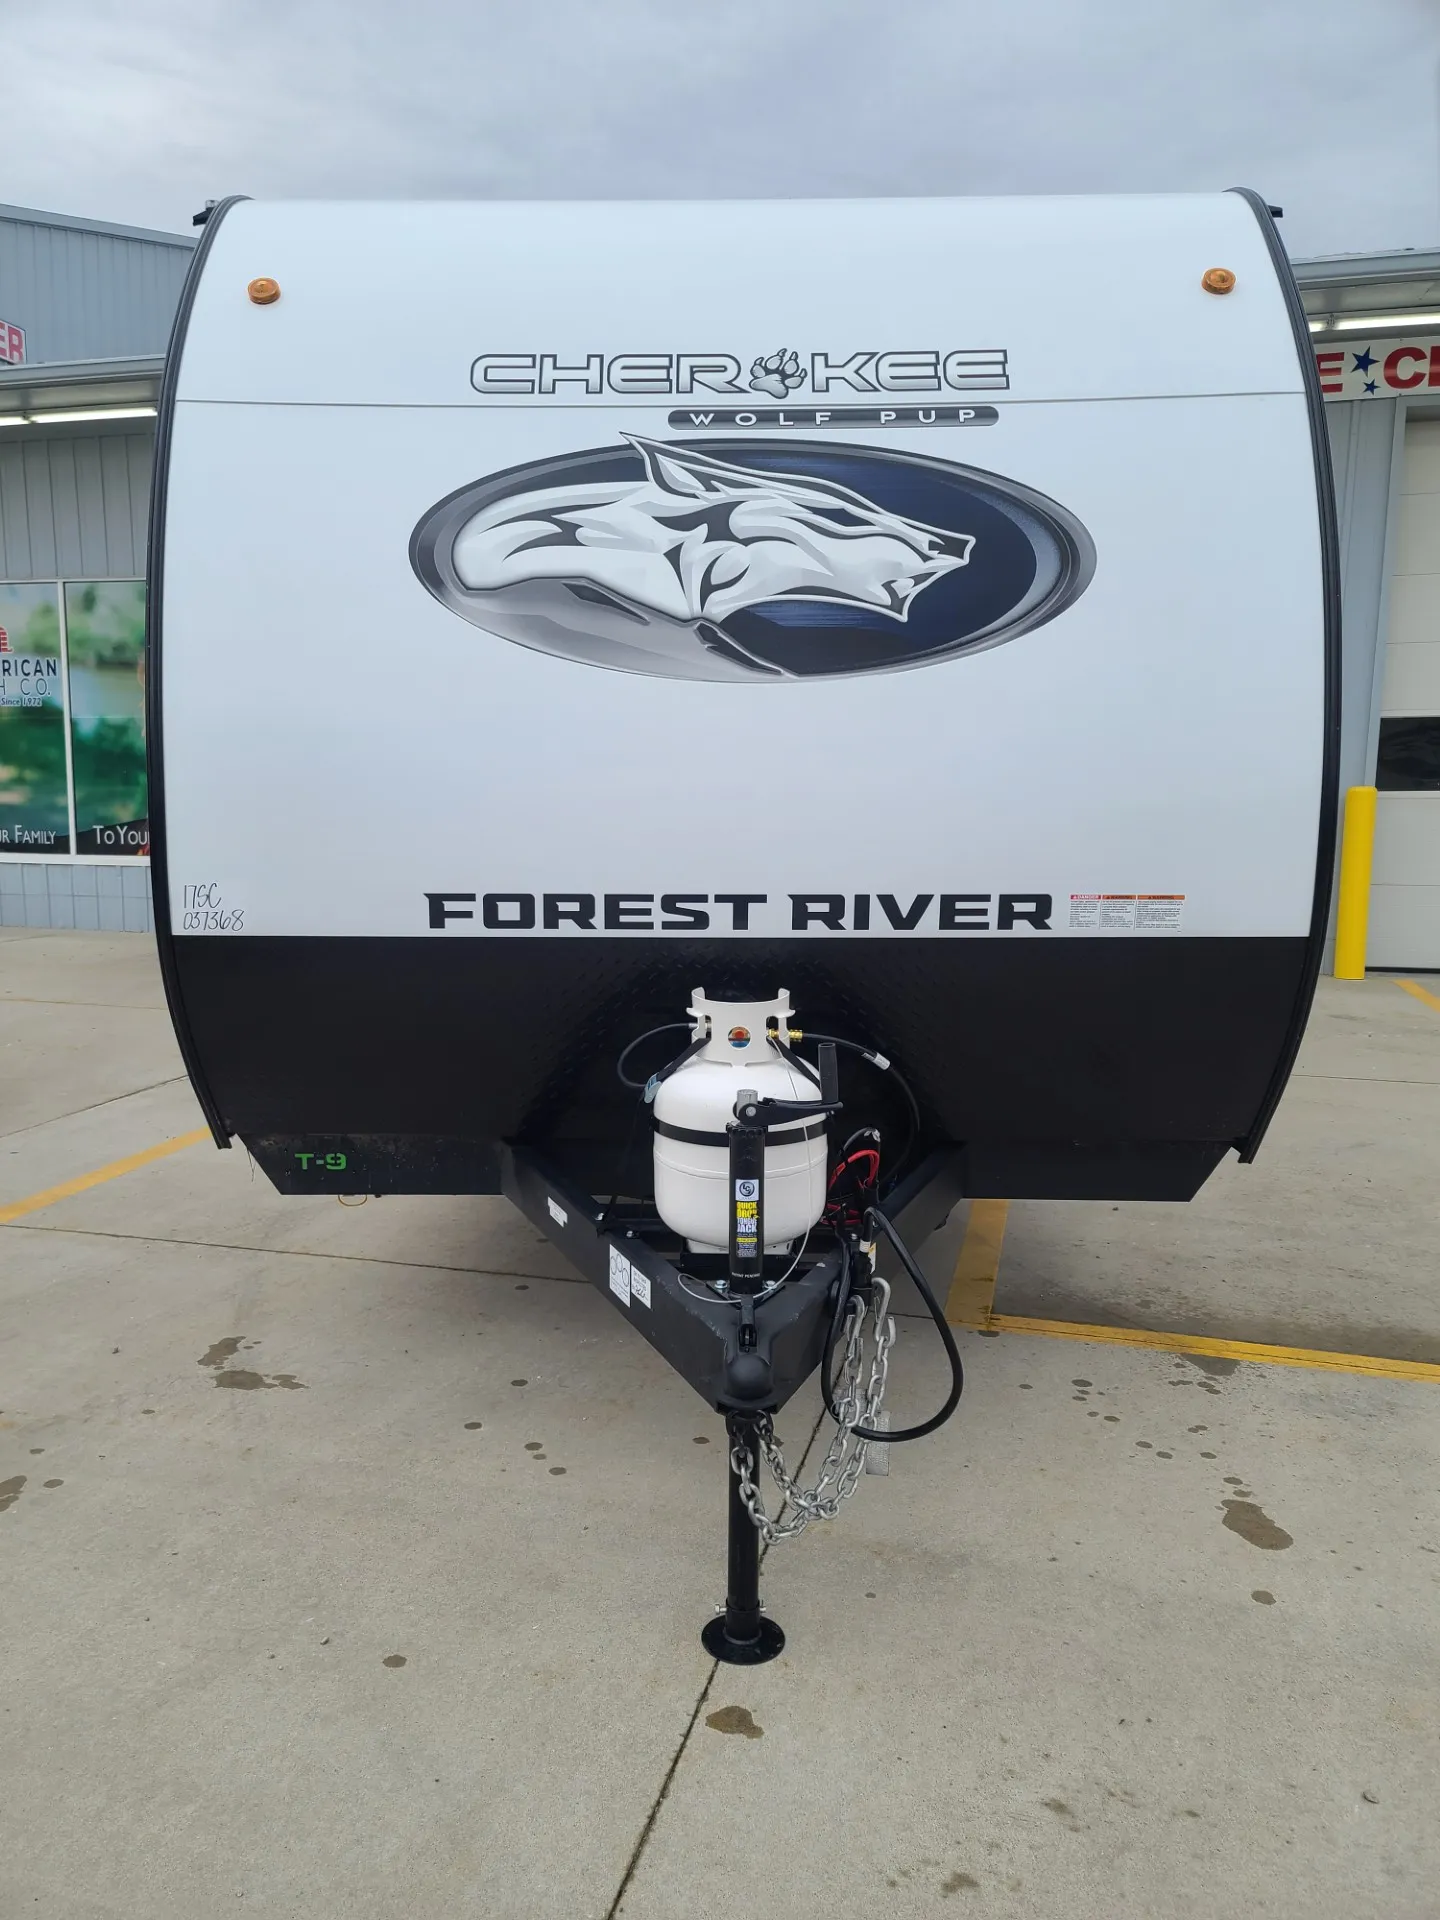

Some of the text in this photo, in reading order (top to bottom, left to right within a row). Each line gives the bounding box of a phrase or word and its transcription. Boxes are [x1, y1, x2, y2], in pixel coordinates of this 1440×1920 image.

[688, 409, 976, 427] WOLF PUP
[20, 678, 51, 695] CO.
[1, 697, 20, 706] Since
[183, 909, 245, 931] 037368
[423, 893, 767, 930] FOREST
[787, 893, 1053, 930] RIVER
[294, 1152, 347, 1170] T-9
[736, 1201, 758, 1209] QUICK
[737, 1224, 758, 1233] JACK
